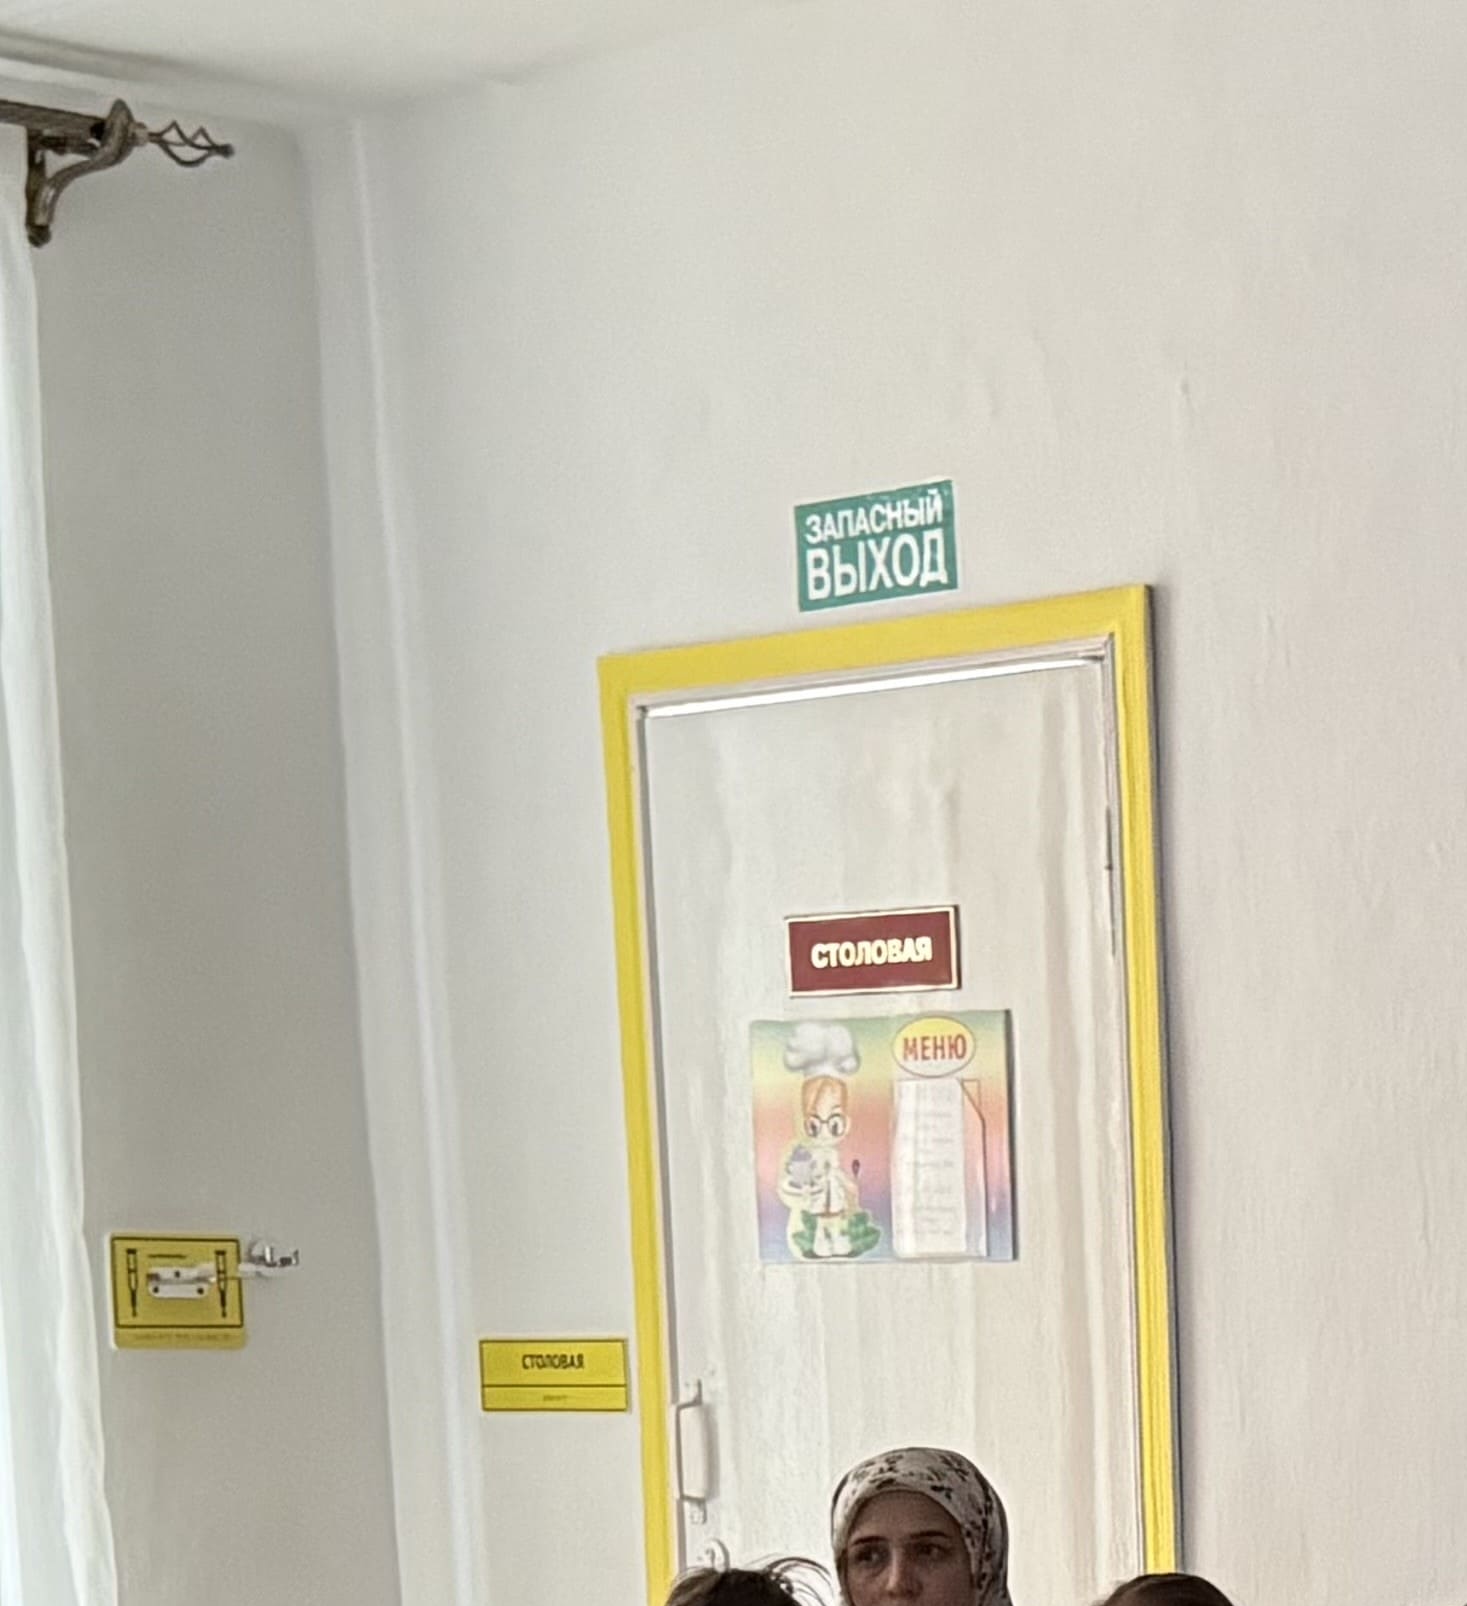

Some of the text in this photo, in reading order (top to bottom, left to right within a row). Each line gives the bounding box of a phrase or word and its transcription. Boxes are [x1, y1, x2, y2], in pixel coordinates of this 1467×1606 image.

[804, 488, 944, 545] ЗАПАСНЫЙ
[806, 528, 949, 601] ВЫХОД
[810, 935, 934, 969] СТОЛОВАЯ
[902, 1033, 968, 1063] МЕНЮ
[522, 1353, 585, 1370] СТОЛОВАЯ
